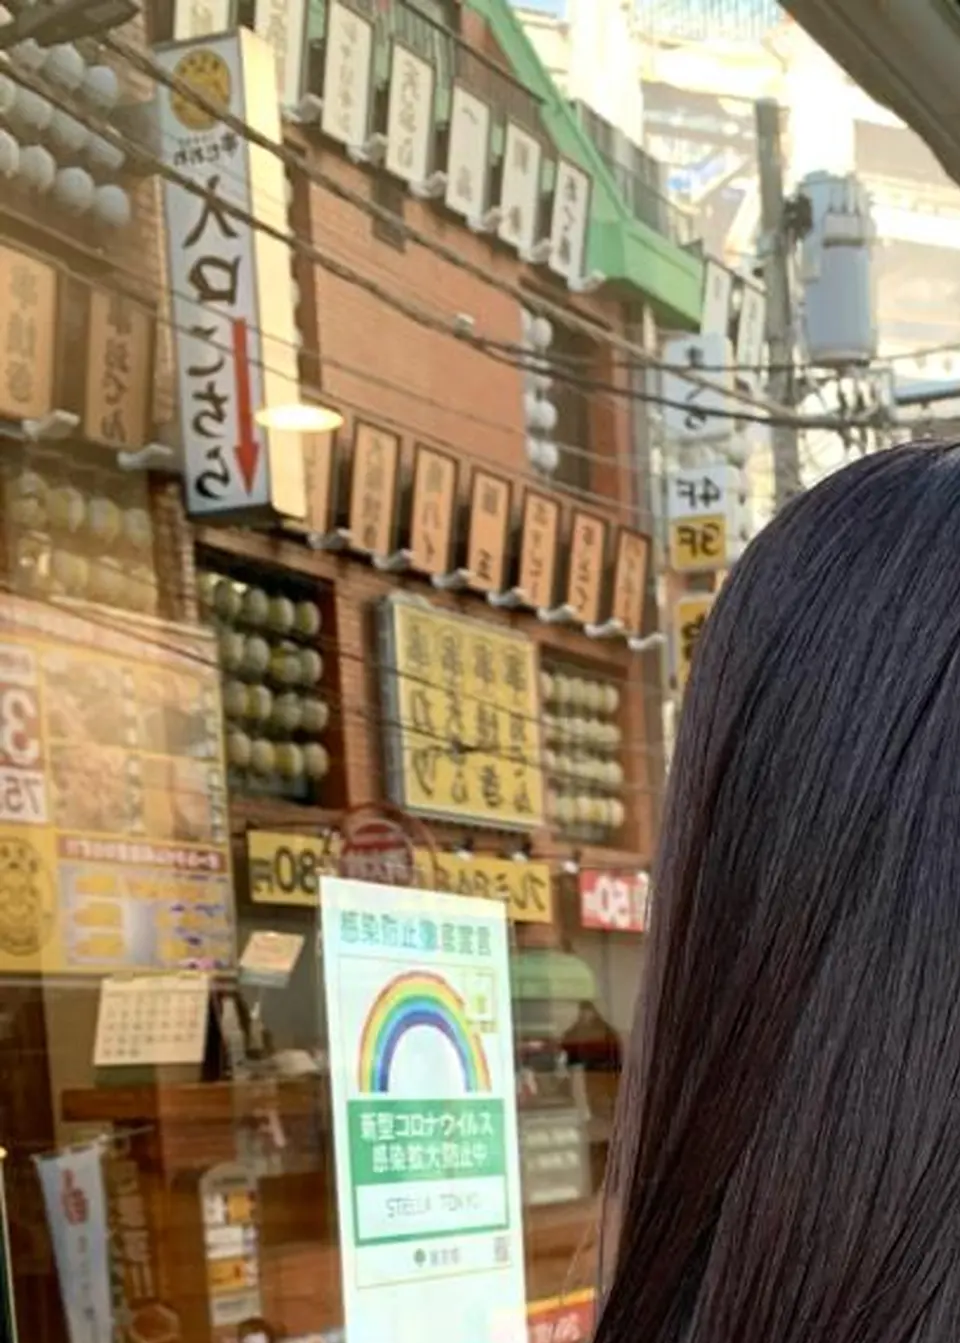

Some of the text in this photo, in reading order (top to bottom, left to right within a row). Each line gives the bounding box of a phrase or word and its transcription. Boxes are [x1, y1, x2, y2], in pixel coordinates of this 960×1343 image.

[360, 1112, 494, 1141] 新型コロナウイルス
